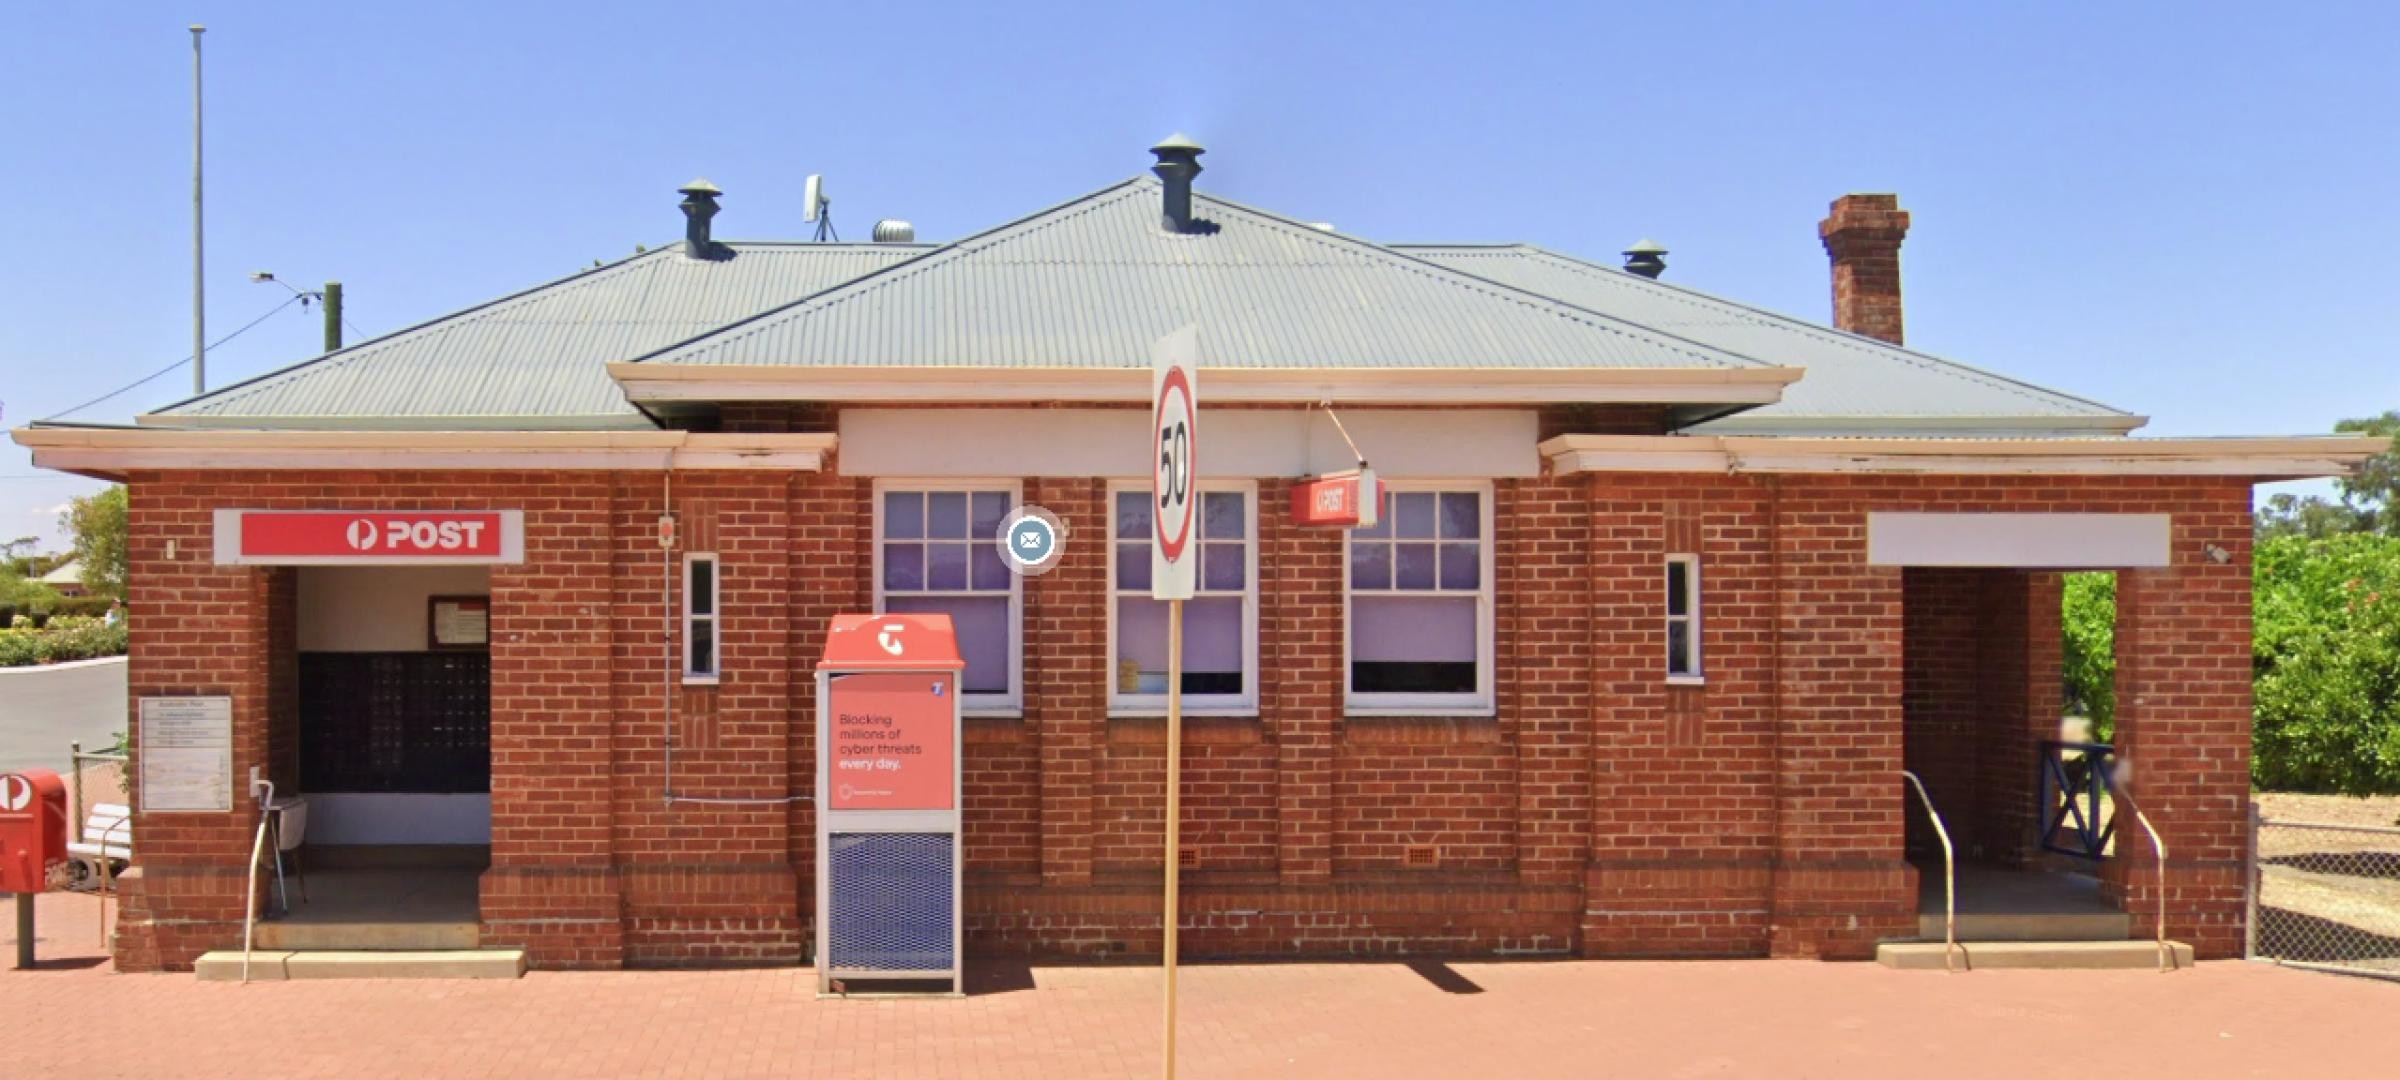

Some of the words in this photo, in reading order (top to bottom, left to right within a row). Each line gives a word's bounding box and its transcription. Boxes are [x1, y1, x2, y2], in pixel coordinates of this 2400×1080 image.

[1161, 421, 1186, 509] 50
[1322, 487, 1344, 512] POST
[387, 520, 485, 549] POST
[839, 713, 892, 728] Blocking
[839, 728, 885, 740] millions
[888, 728, 901, 740] of
[839, 743, 874, 756] cyber
[877, 743, 922, 755] threats
[839, 759, 873, 771] every
[876, 758, 901, 771] day.
